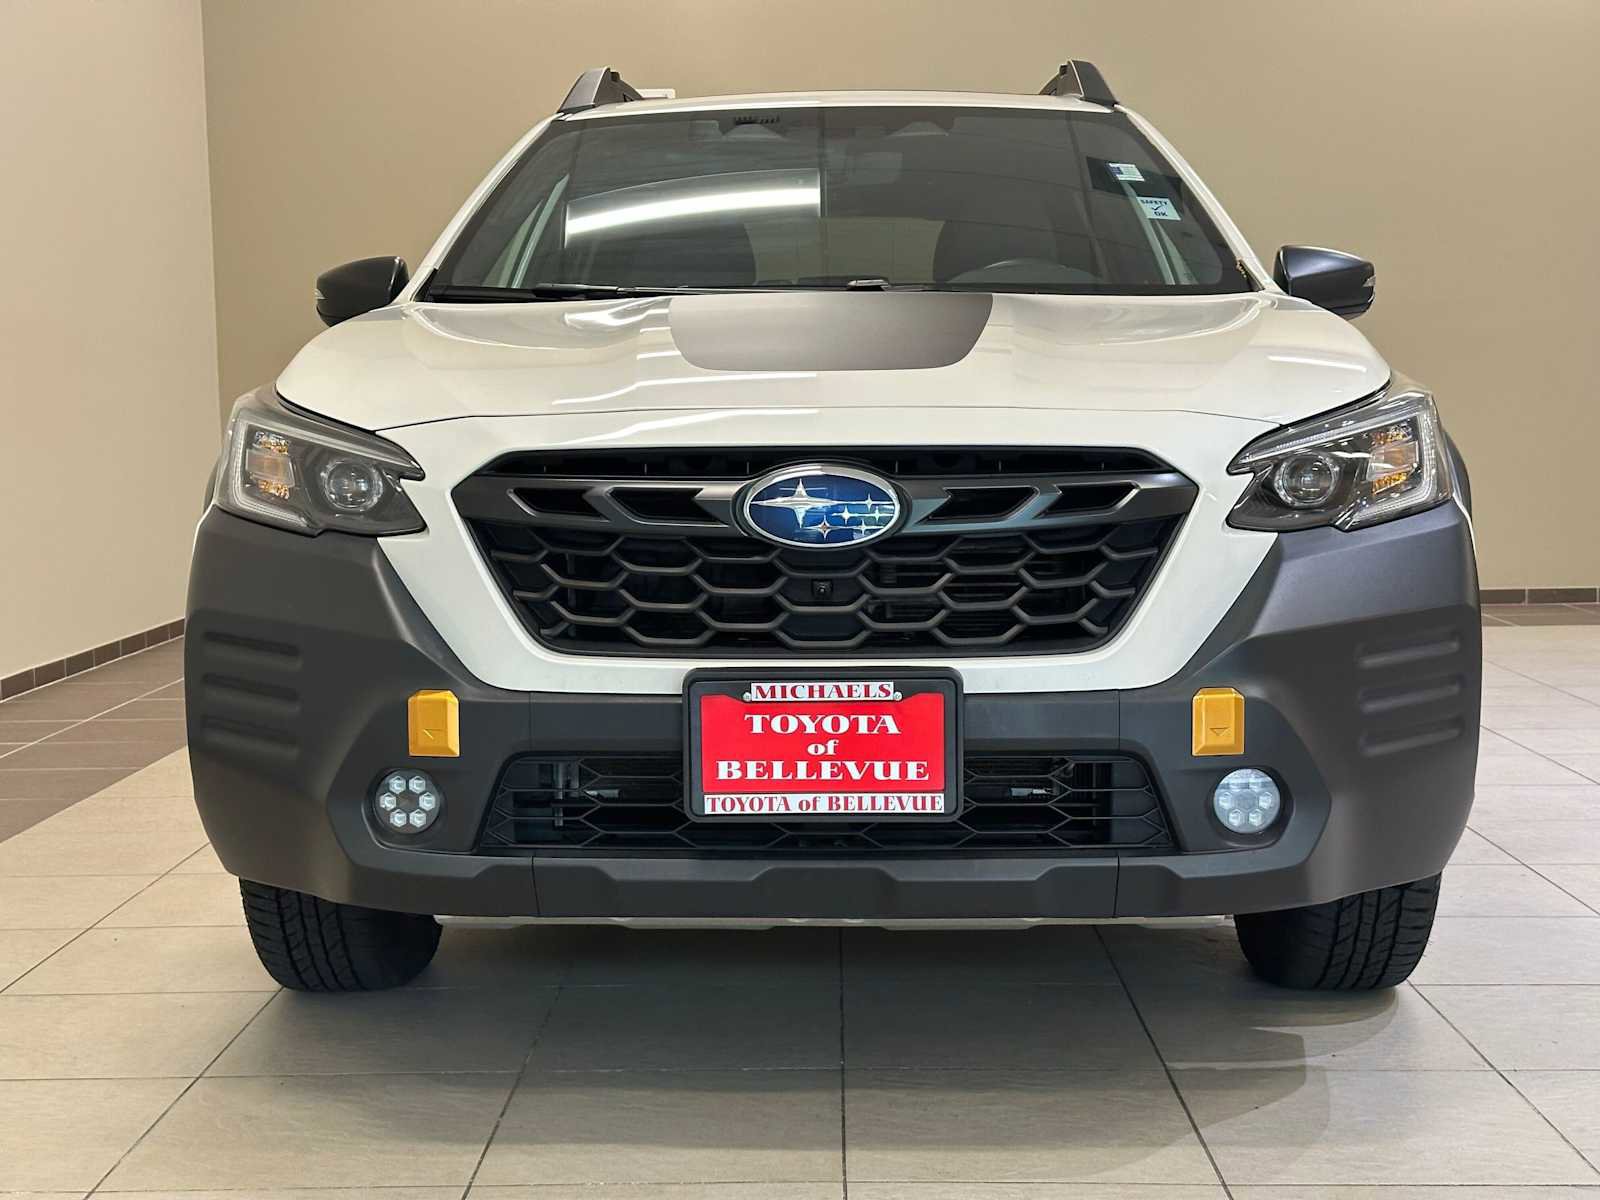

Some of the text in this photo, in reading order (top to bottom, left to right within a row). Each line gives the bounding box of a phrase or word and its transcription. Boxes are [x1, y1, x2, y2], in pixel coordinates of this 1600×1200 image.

[754, 683, 892, 699] MICHAELS
[744, 714, 901, 735] TOYOTA
[807, 739, 839, 755] of
[716, 760, 930, 781] BELLEVUE
[706, 795, 943, 812] TOYOTA of BELLEVUE
